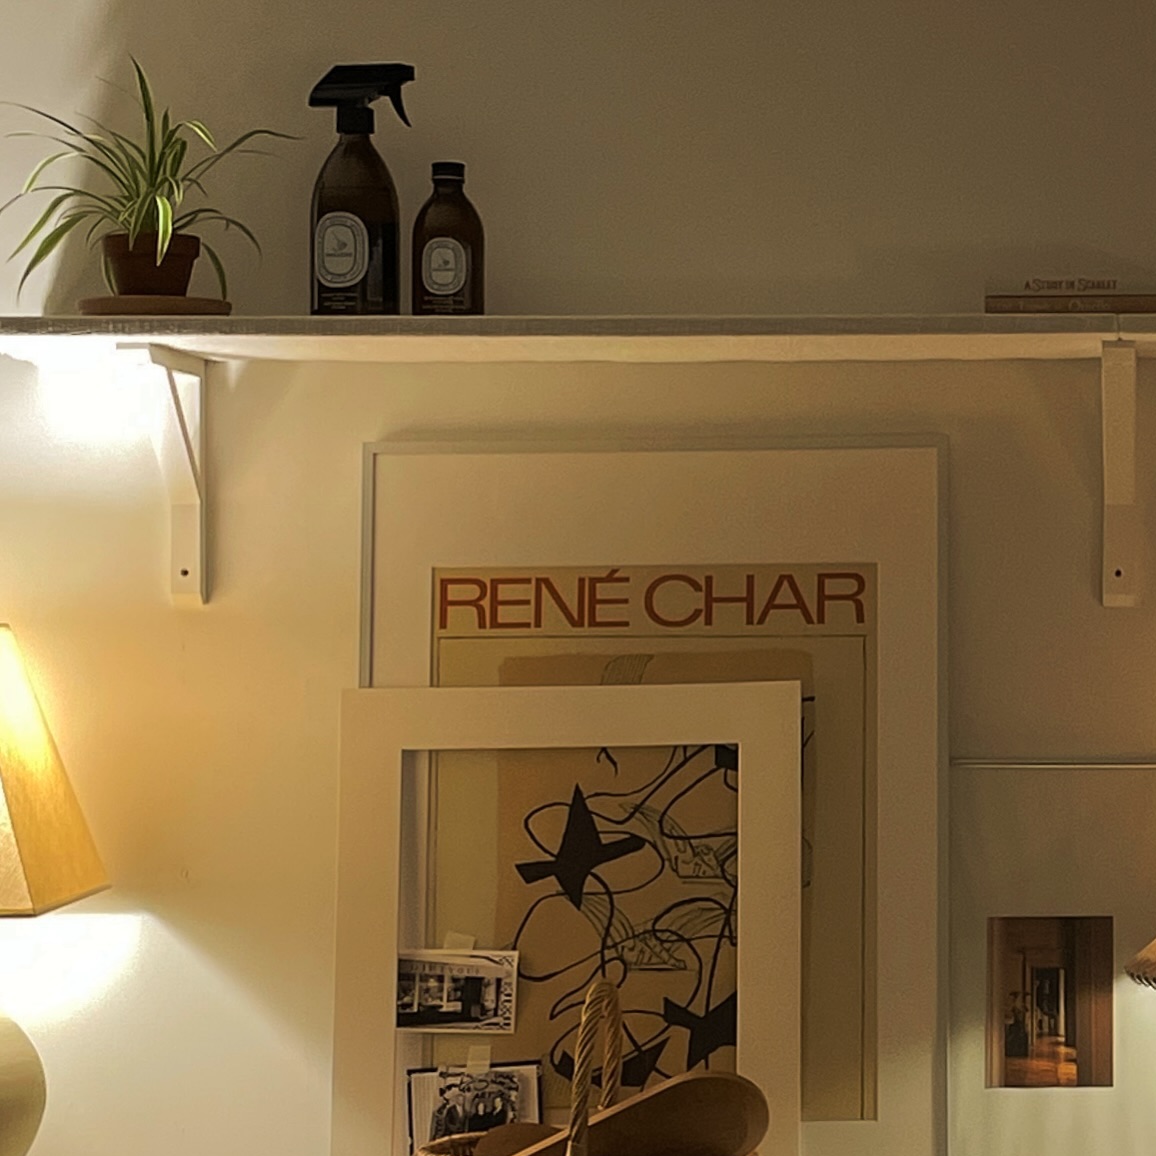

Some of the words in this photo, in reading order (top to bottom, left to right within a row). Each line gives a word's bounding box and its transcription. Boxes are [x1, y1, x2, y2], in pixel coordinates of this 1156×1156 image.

[1024, 280, 1031, 290] A
[438, 568, 630, 630] RENÉ
[643, 573, 866, 628] CHAR
